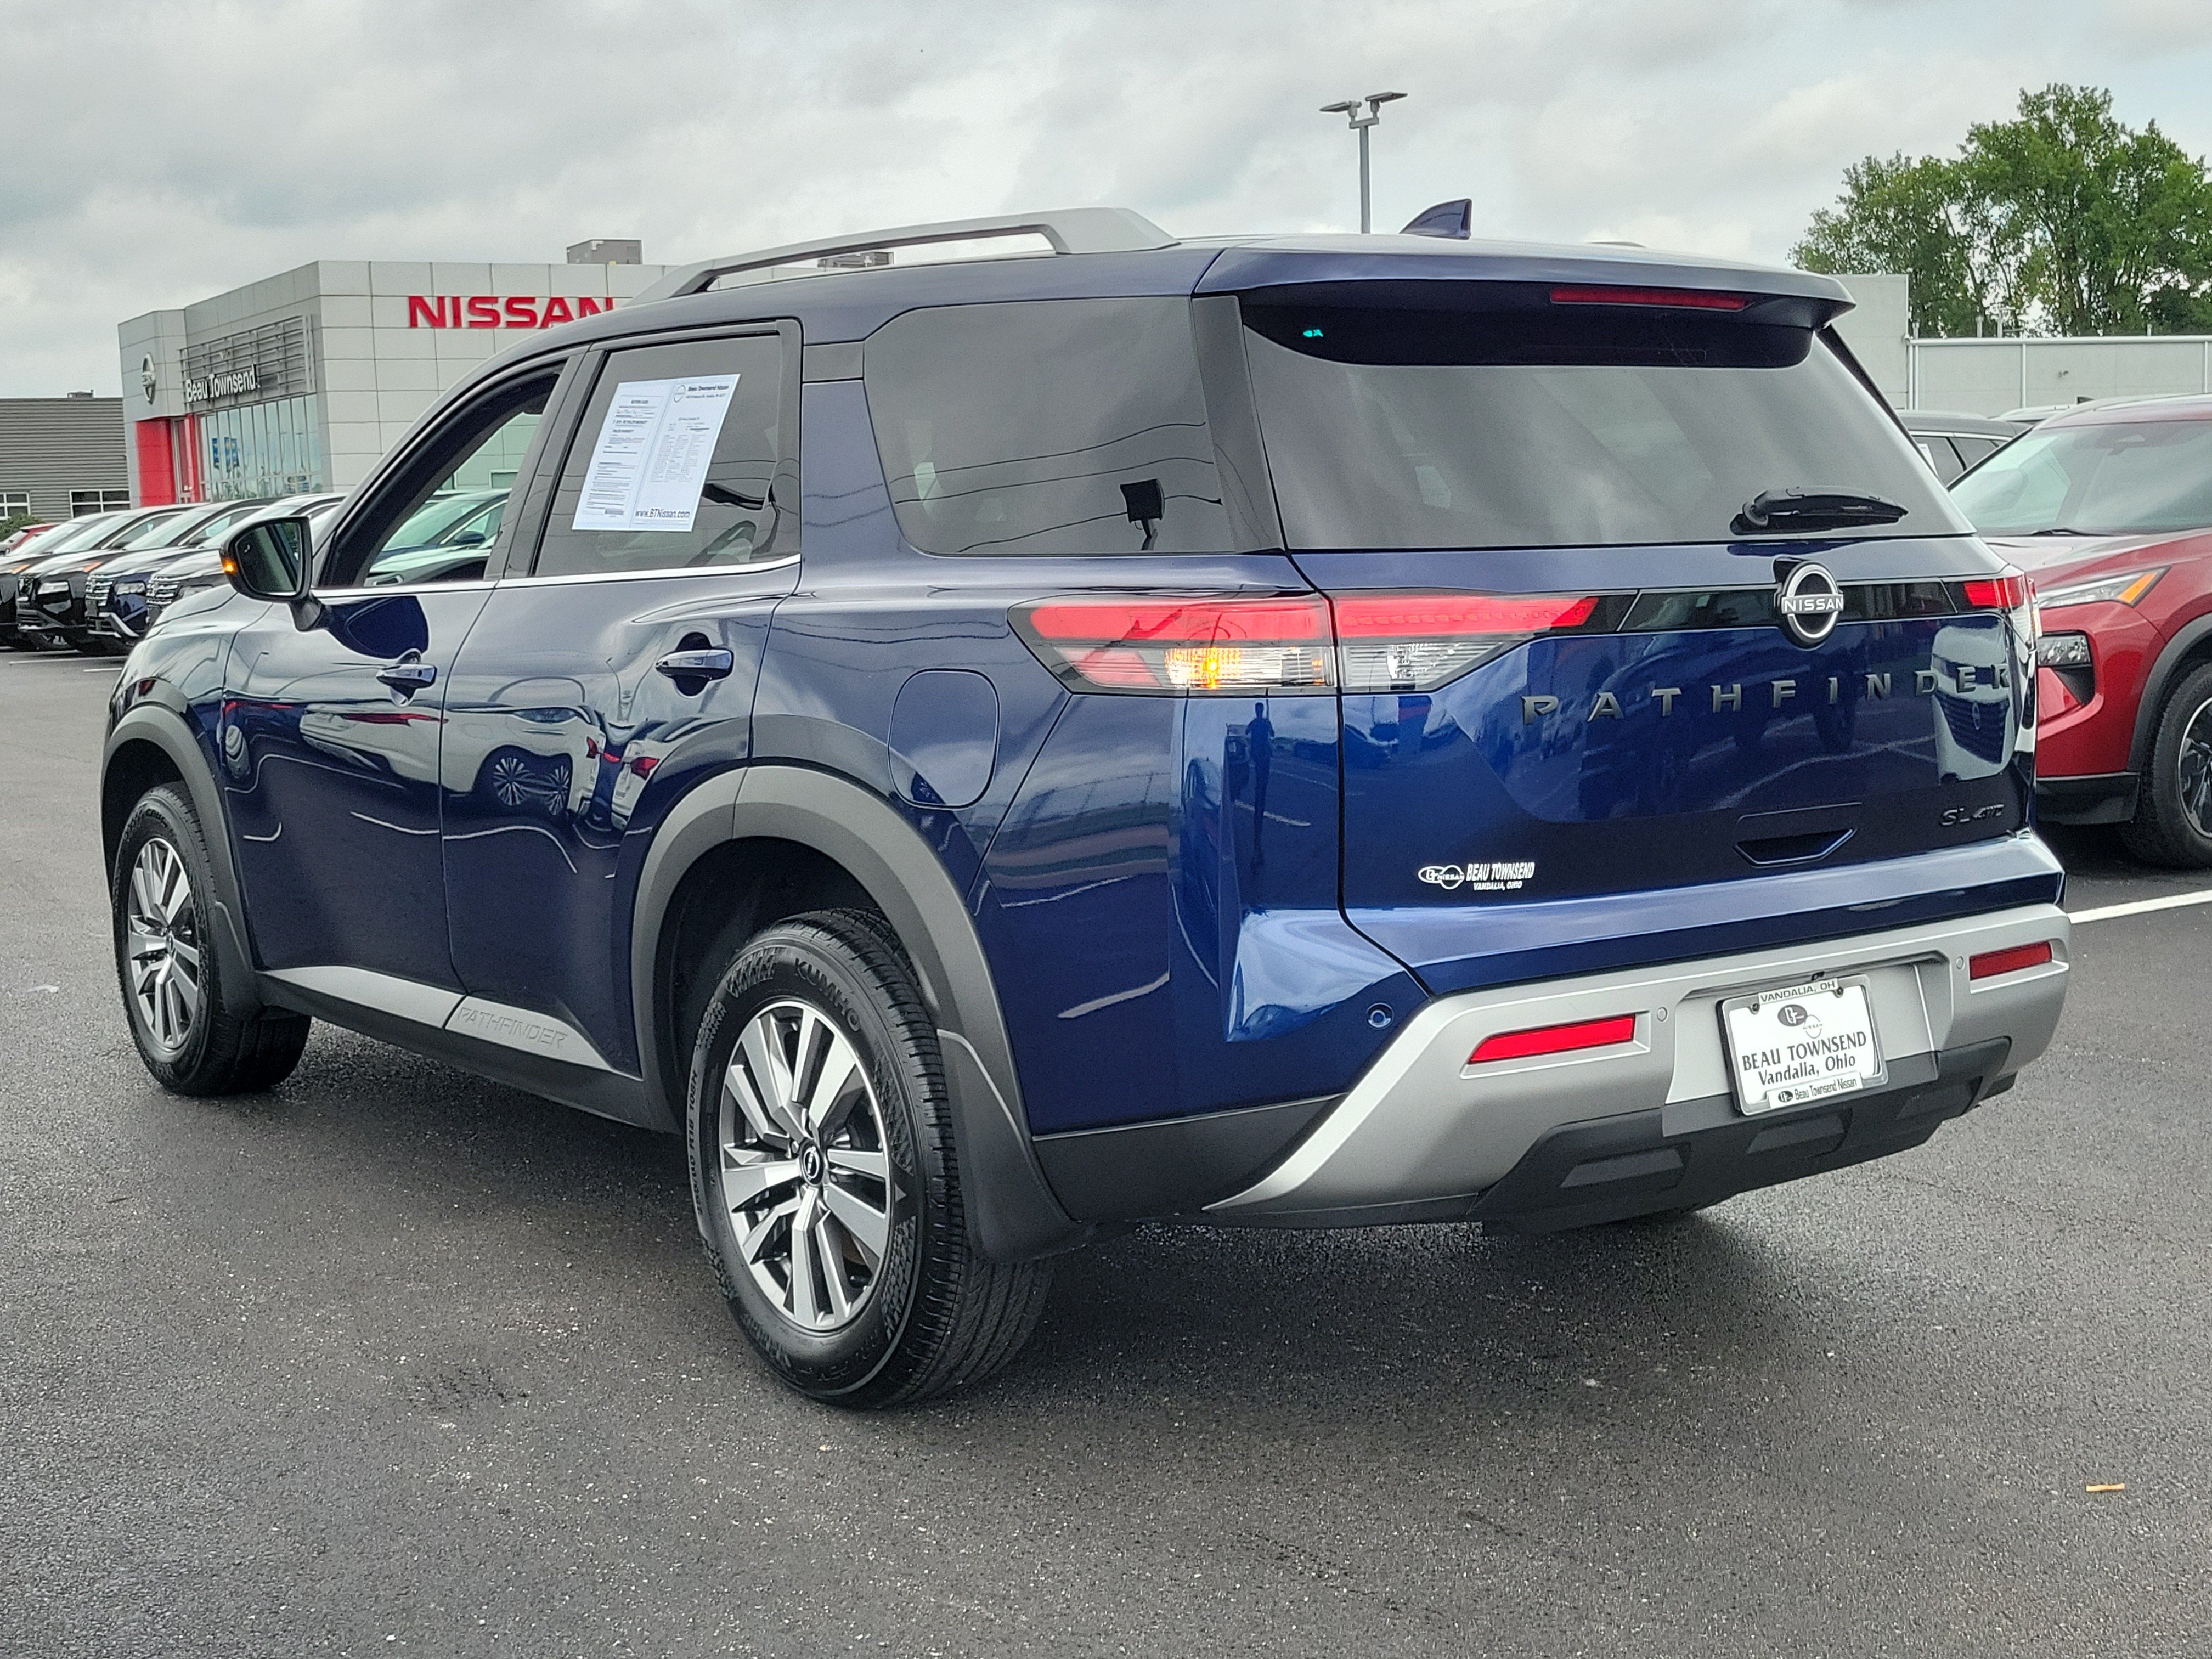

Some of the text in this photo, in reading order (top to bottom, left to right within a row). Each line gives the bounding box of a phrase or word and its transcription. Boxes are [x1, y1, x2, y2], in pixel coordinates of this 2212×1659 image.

[409, 296, 613, 328] NISSAN
[185, 379, 208, 402] Beau
[635, 508, 690, 518] www.BTNissan.com
[1784, 597, 1843, 612] NISSAN
[1520, 663, 2010, 725] PATHFINDER
[1466, 862, 1535, 882] BEAU TOWNSEND
[1474, 881, 1523, 891] VANDALIA, OHIO
[794, 957, 861, 1032] KUMHO
[1820, 981, 1836, 990] OH
[457, 1007, 568, 1049] PATHFINDER
[1742, 1031, 1866, 1071] BEAU TOWNSEND
[1758, 1053, 1856, 1086] Vandalia, Ohio
[1794, 1088, 1810, 1101] Beau
[1809, 1079, 1837, 1097] Townsend
[1837, 1078, 1858, 1091] Nissan
